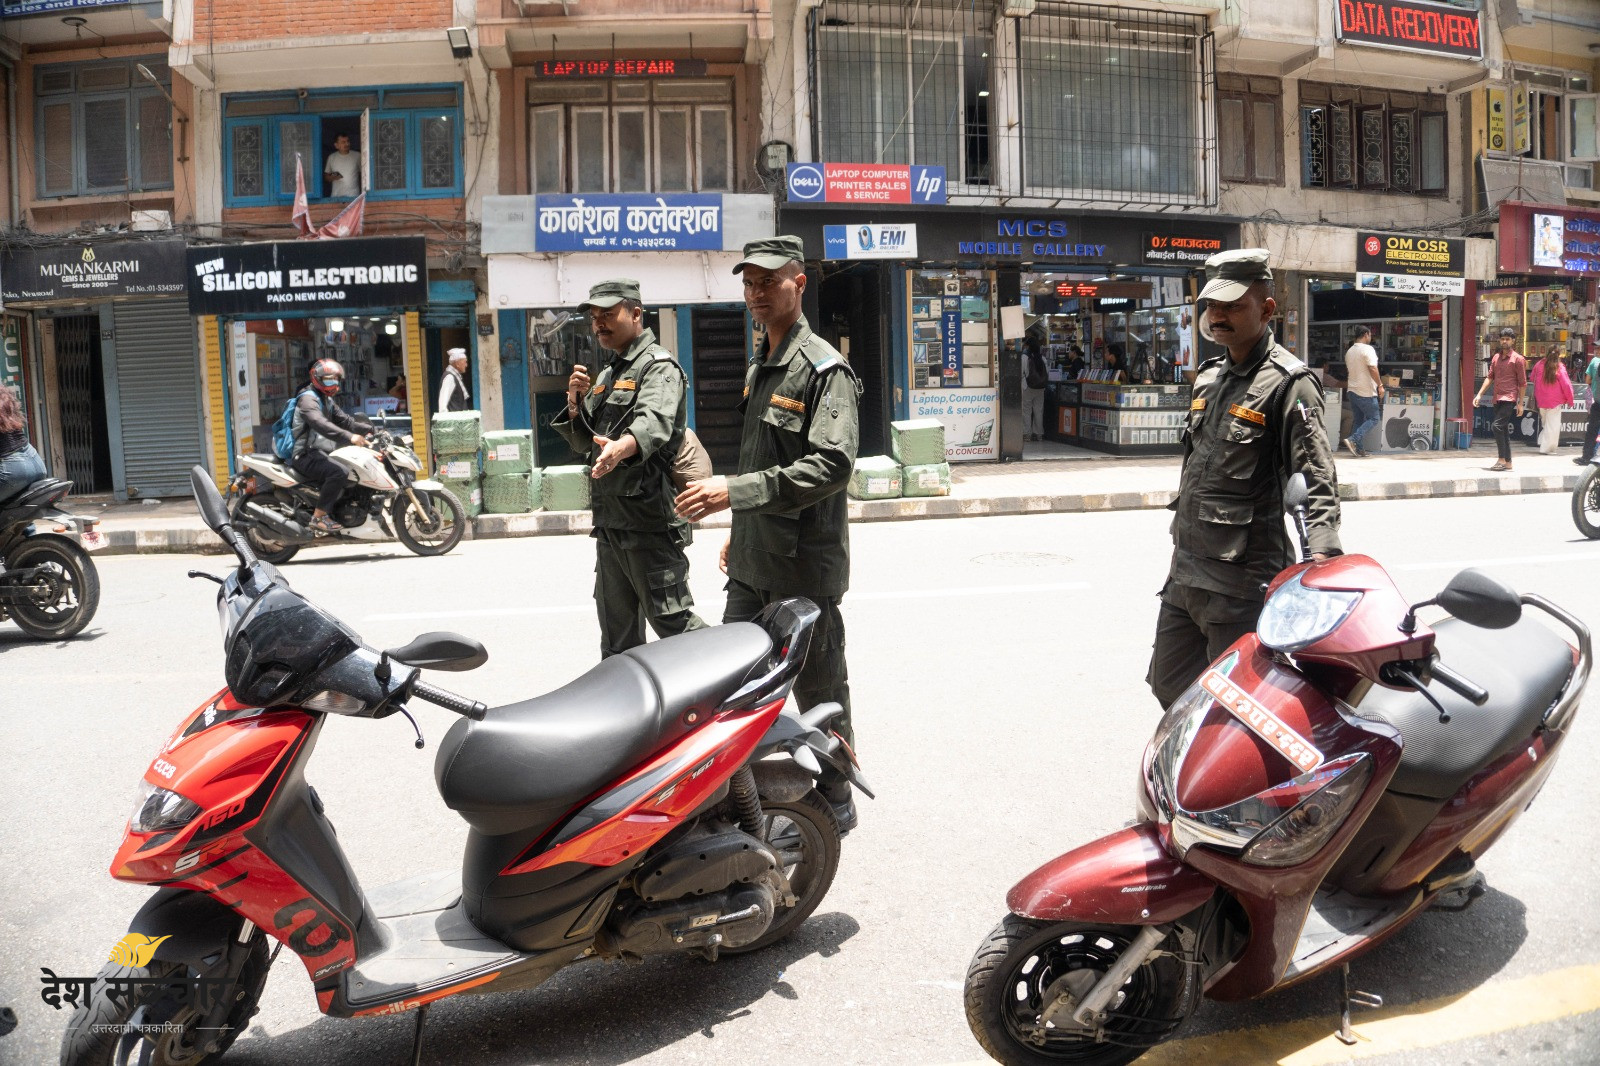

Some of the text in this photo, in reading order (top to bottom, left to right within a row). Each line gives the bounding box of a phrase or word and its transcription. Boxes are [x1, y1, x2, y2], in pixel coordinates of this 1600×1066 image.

[4, 4, 42, 14] Sales
[46, 0, 73, 9] and
[1341, 0, 1479, 49] DATA RECOVERY
[543, 60, 675, 75] LAPTOP REPAIR
[826, 170, 909, 179] LAPTOP COMPUTER
[793, 178, 819, 187] DELL
[829, 181, 907, 191] PRINTER SALES
[915, 169, 941, 201] hp
[845, 191, 890, 200] & SERVICE
[539, 198, 719, 235] कार्नेशन कलेक्शन
[997, 219, 1067, 237] MCS
[583, 236, 606, 246] सम्पर्क
[879, 231, 906, 245] EMI
[1171, 237, 1221, 249] ब्याजदरमा
[1387, 237, 1449, 253] OM OSR
[958, 242, 1106, 257] MOBILE GALLERY
[1386, 250, 1449, 262] ELECTRONICS
[40, 260, 139, 277] MUNANKARMI
[195, 258, 225, 276] NEW
[62, 273, 118, 283] GEMS & JEWELLERS
[202, 264, 418, 292] SILICON ELECTRONIC
[1484, 277, 1519, 288] SAMSUNG
[267, 291, 346, 303] PAKO NEW ROAD
[948, 314, 957, 369] TECH PRO
[918, 405, 990, 415] Sales & service
[956, 447, 993, 455] CONCERN
[201, 798, 246, 832] 160
